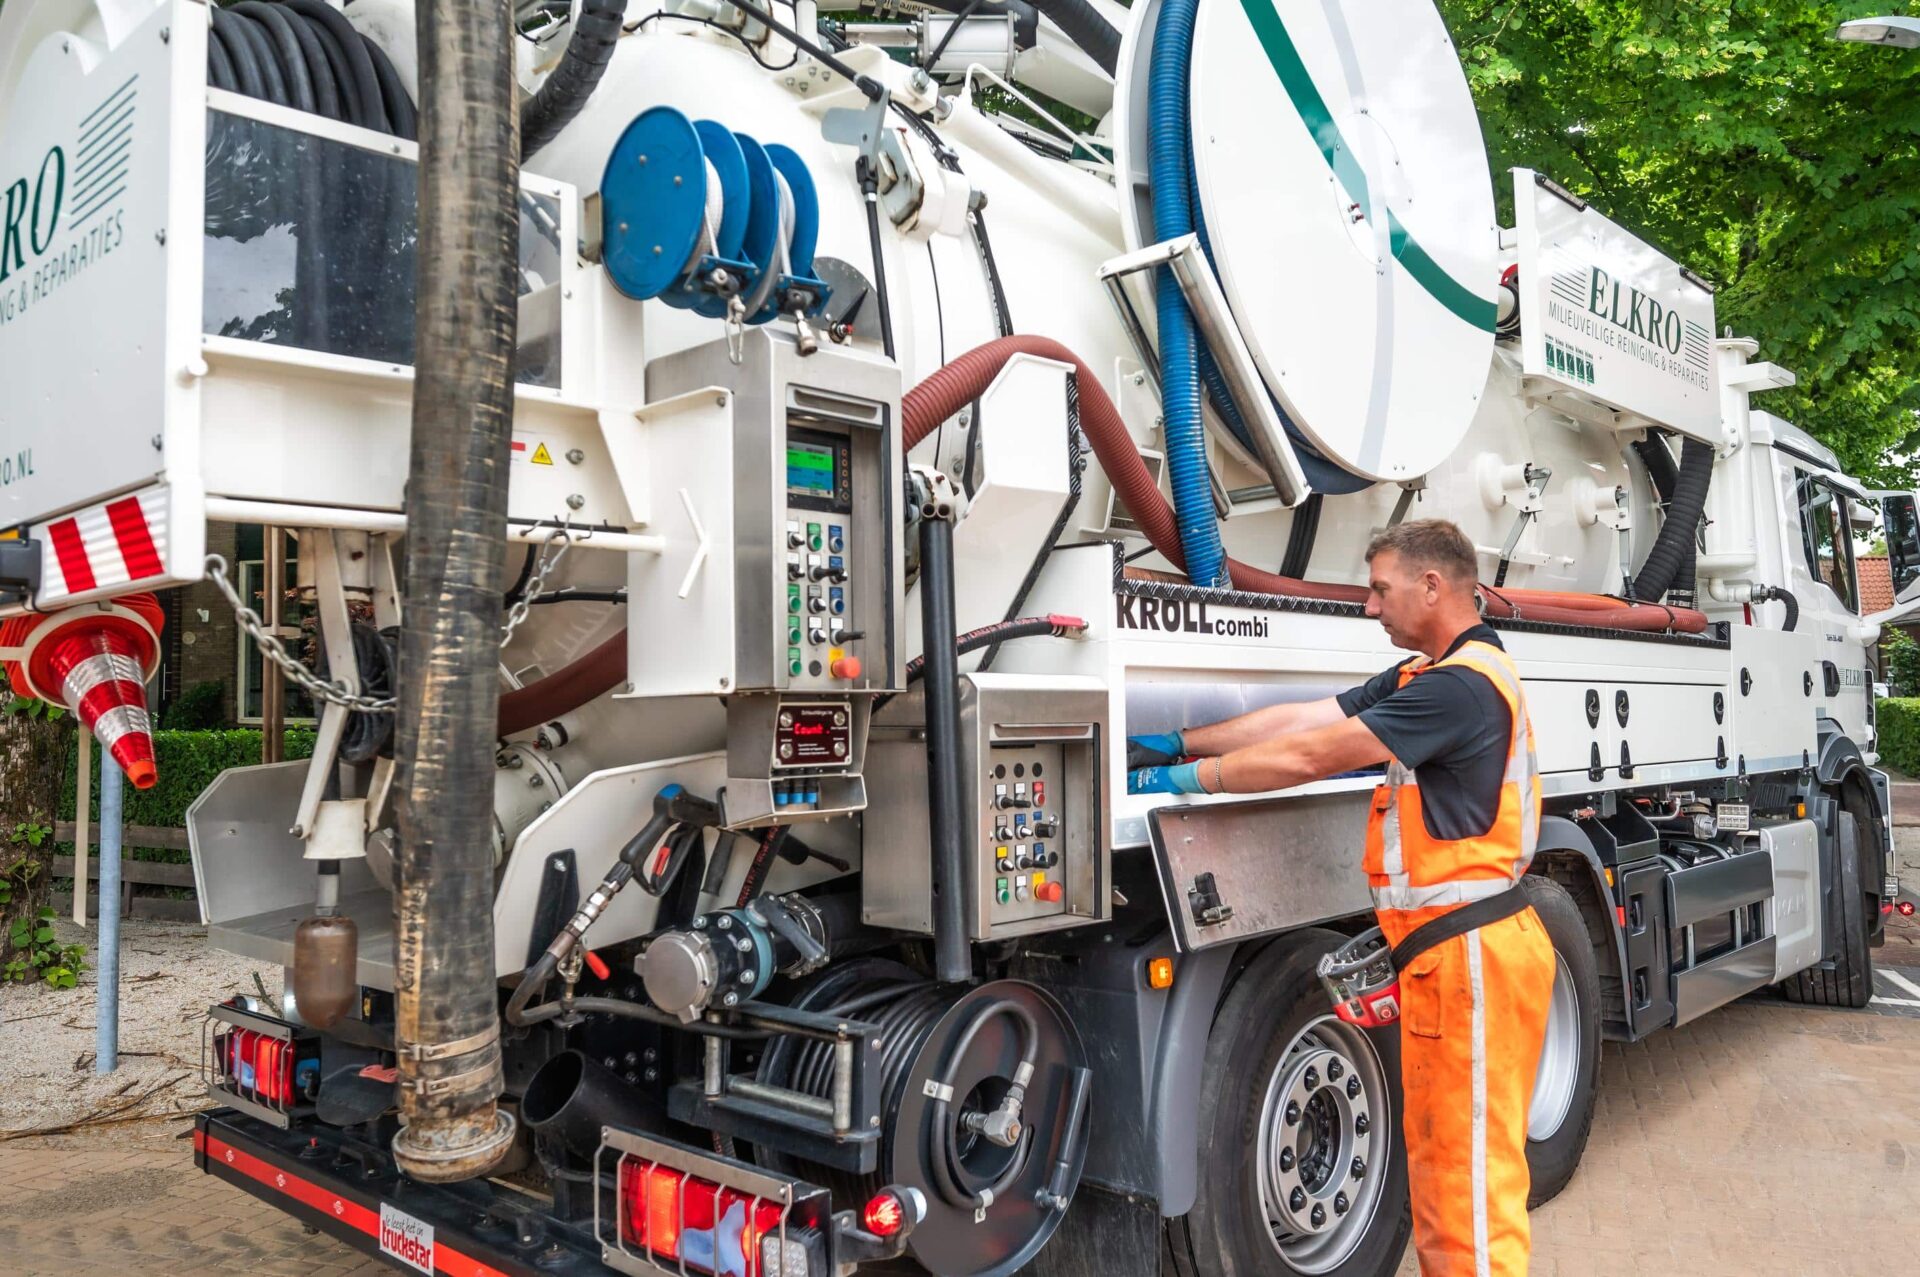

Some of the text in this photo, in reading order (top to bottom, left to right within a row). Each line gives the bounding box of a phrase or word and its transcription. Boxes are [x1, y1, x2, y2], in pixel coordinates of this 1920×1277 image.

[0, 145, 65, 283] RO
[19, 281, 28, 313] &
[33, 209, 123, 304] REPARATIES
[1548, 301, 1614, 347] MILIEUVEILIGE
[1617, 334, 1659, 368] REINIGING
[1661, 356, 1667, 371] &
[1668, 360, 1709, 391] REPARATIES
[1588, 266, 1682, 355] ELKRO
[1116, 594, 1268, 638] KROLL combi
[382, 1219, 431, 1270] truckstar
